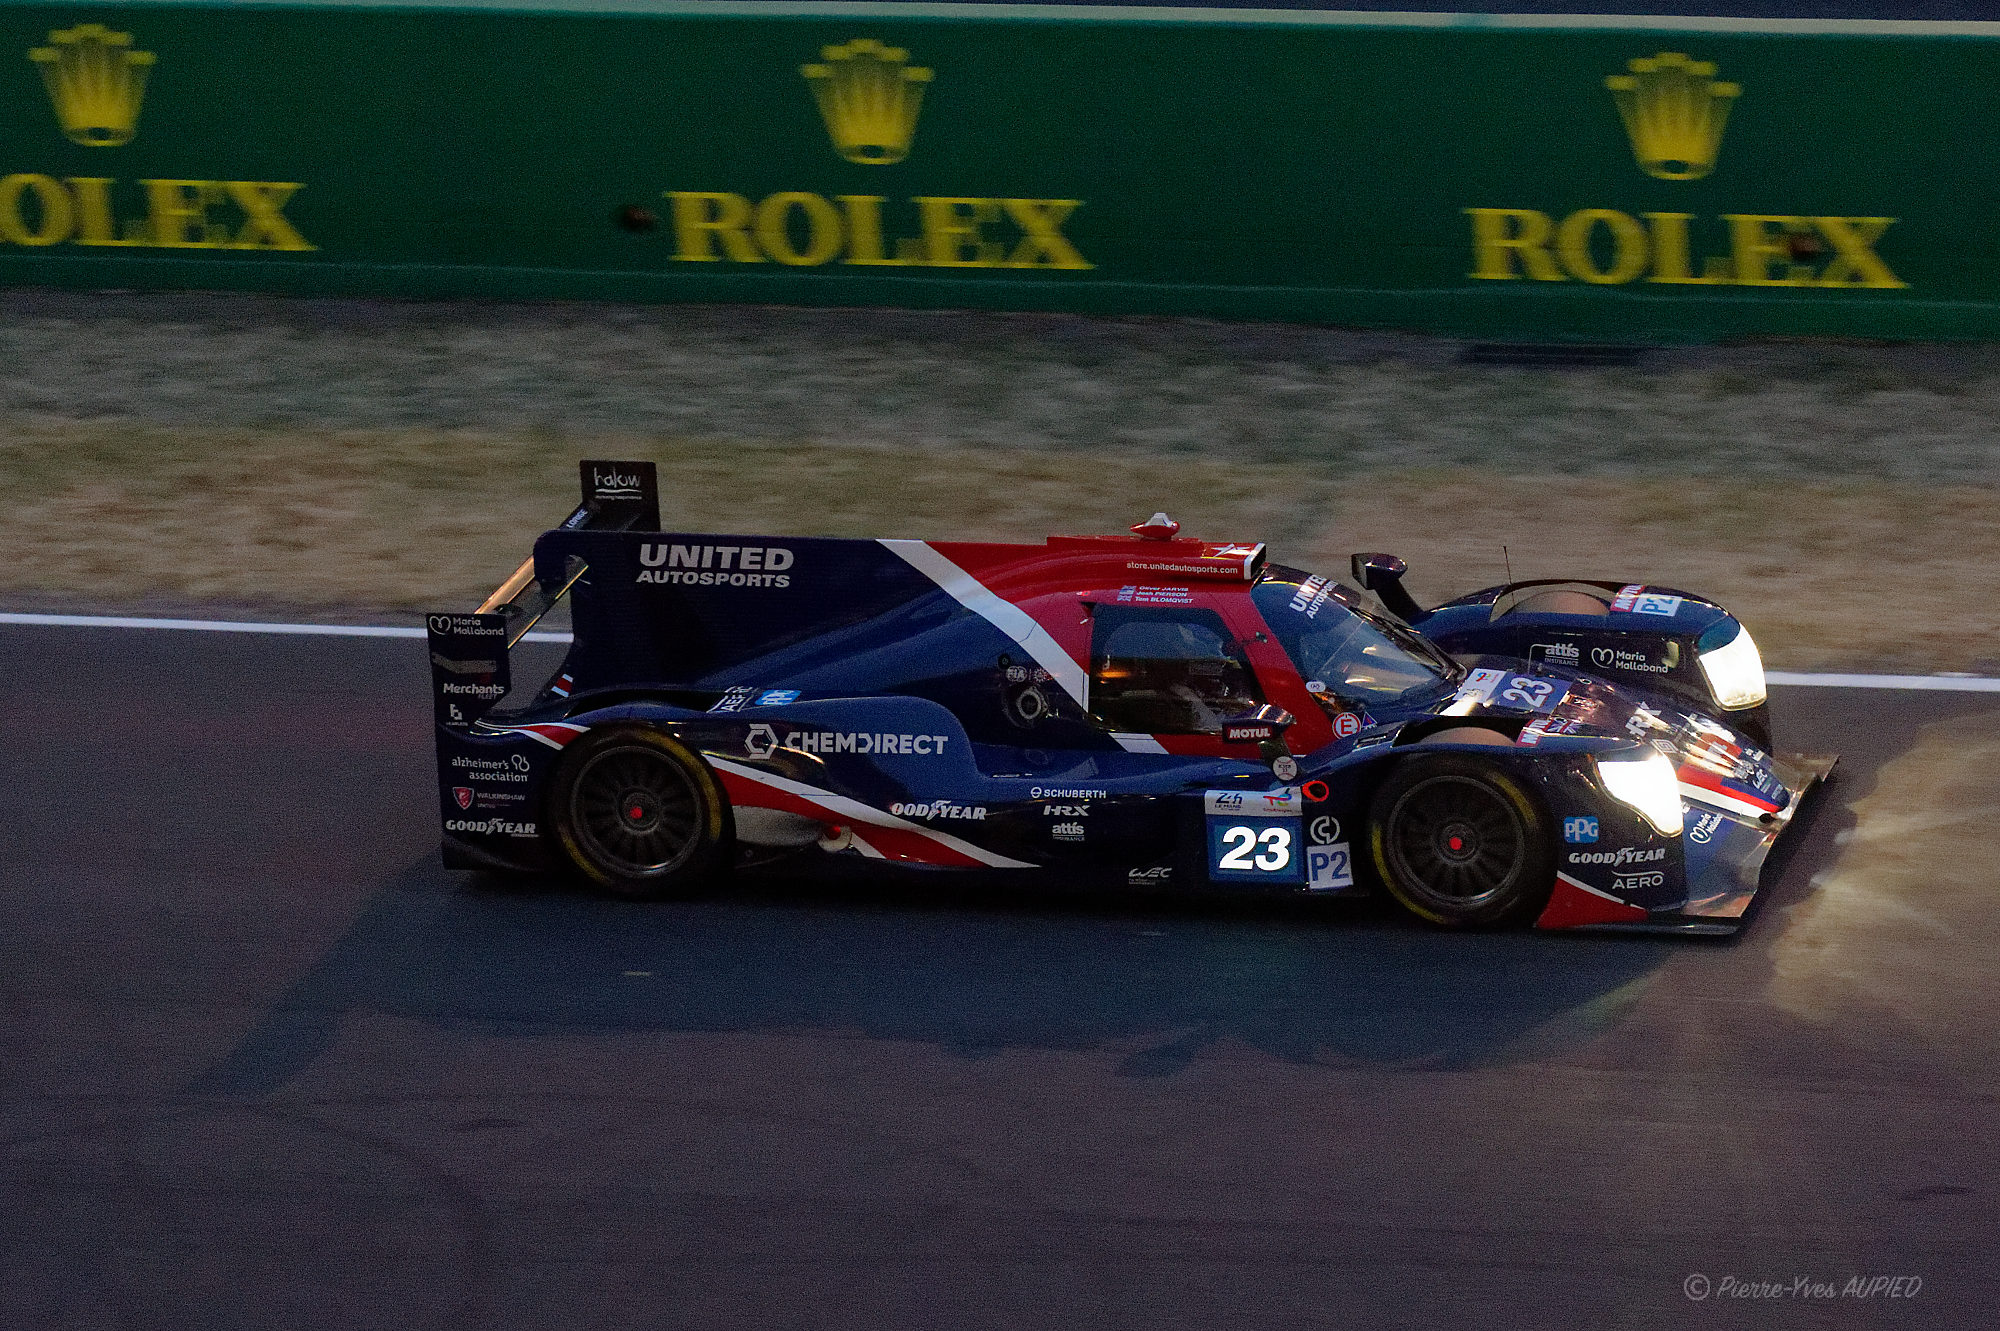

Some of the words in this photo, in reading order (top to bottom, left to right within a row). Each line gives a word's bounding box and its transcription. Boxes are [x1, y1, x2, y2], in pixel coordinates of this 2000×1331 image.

[663, 191, 1096, 270] ROLEX
[1463, 208, 1911, 289] ROLEX
[639, 543, 795, 571] UNITED
[1126, 562, 1238, 574] store.unitedautosports.com
[635, 570, 791, 588] AUTOSPORTS
[452, 616, 482, 627] Maria
[453, 626, 505, 636] Mallaband
[1545, 657, 1579, 667] INSURANCE
[1616, 650, 1646, 662] Maria
[1615, 660, 1669, 674] Mallaband
[443, 682, 505, 695] Merchants
[1502, 677, 1554, 708] 23
[1229, 728, 1271, 739] MOTUL
[1340, 718, 1353, 735] E
[784, 731, 949, 755] CHEMDIRECT
[451, 756, 510, 770] alzheimer's
[469, 770, 529, 783] association
[1044, 789, 1107, 799] SCHUBERTH
[1043, 805, 1091, 816] HRX
[446, 818, 537, 835] GOODYEAR
[1219, 825, 1292, 872] 23
[1568, 847, 1666, 867] GOODYEAR
[1310, 851, 1350, 881] P2
[1611, 875, 1664, 890] AERO
